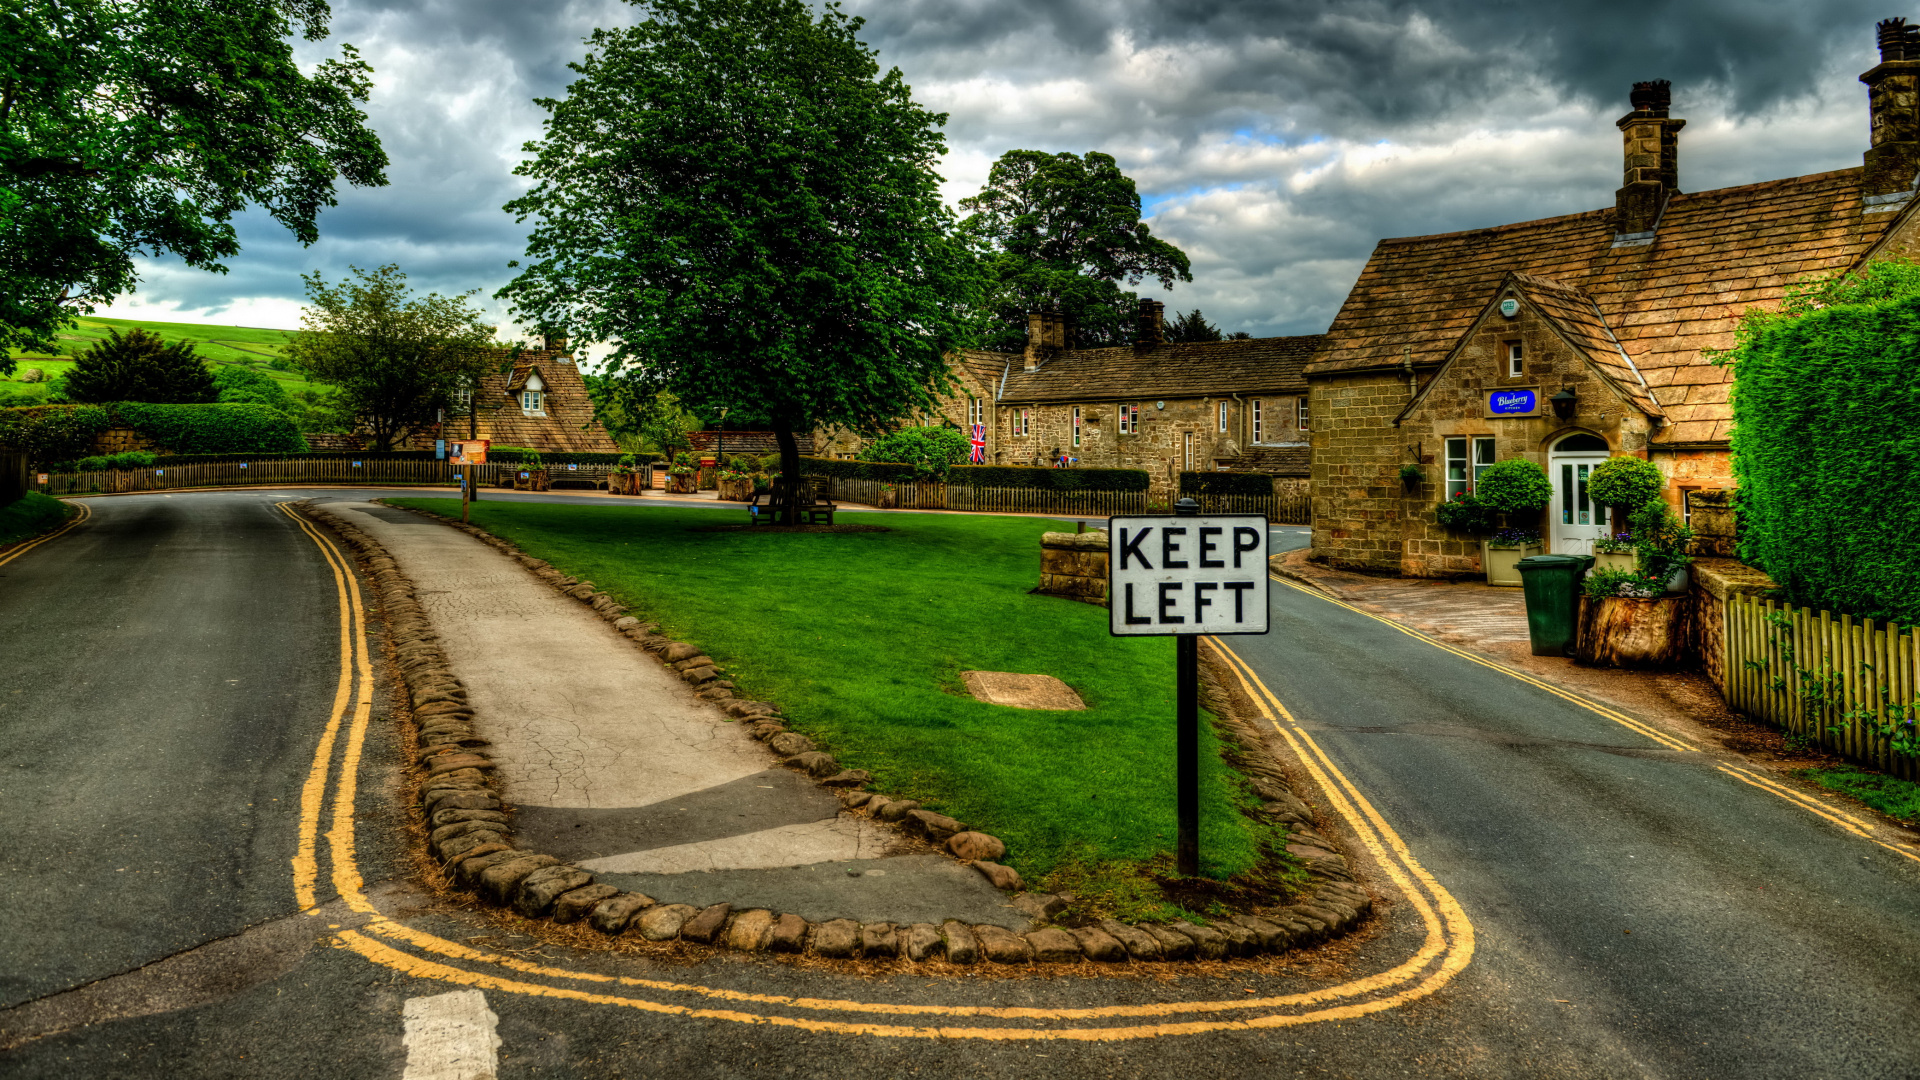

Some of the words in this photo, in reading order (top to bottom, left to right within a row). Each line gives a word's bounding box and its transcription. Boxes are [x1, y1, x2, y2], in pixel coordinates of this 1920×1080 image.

[1498, 394, 1528, 406] Blueberry
[1119, 526, 1261, 570] KEEP
[1125, 581, 1255, 625] LEFT
